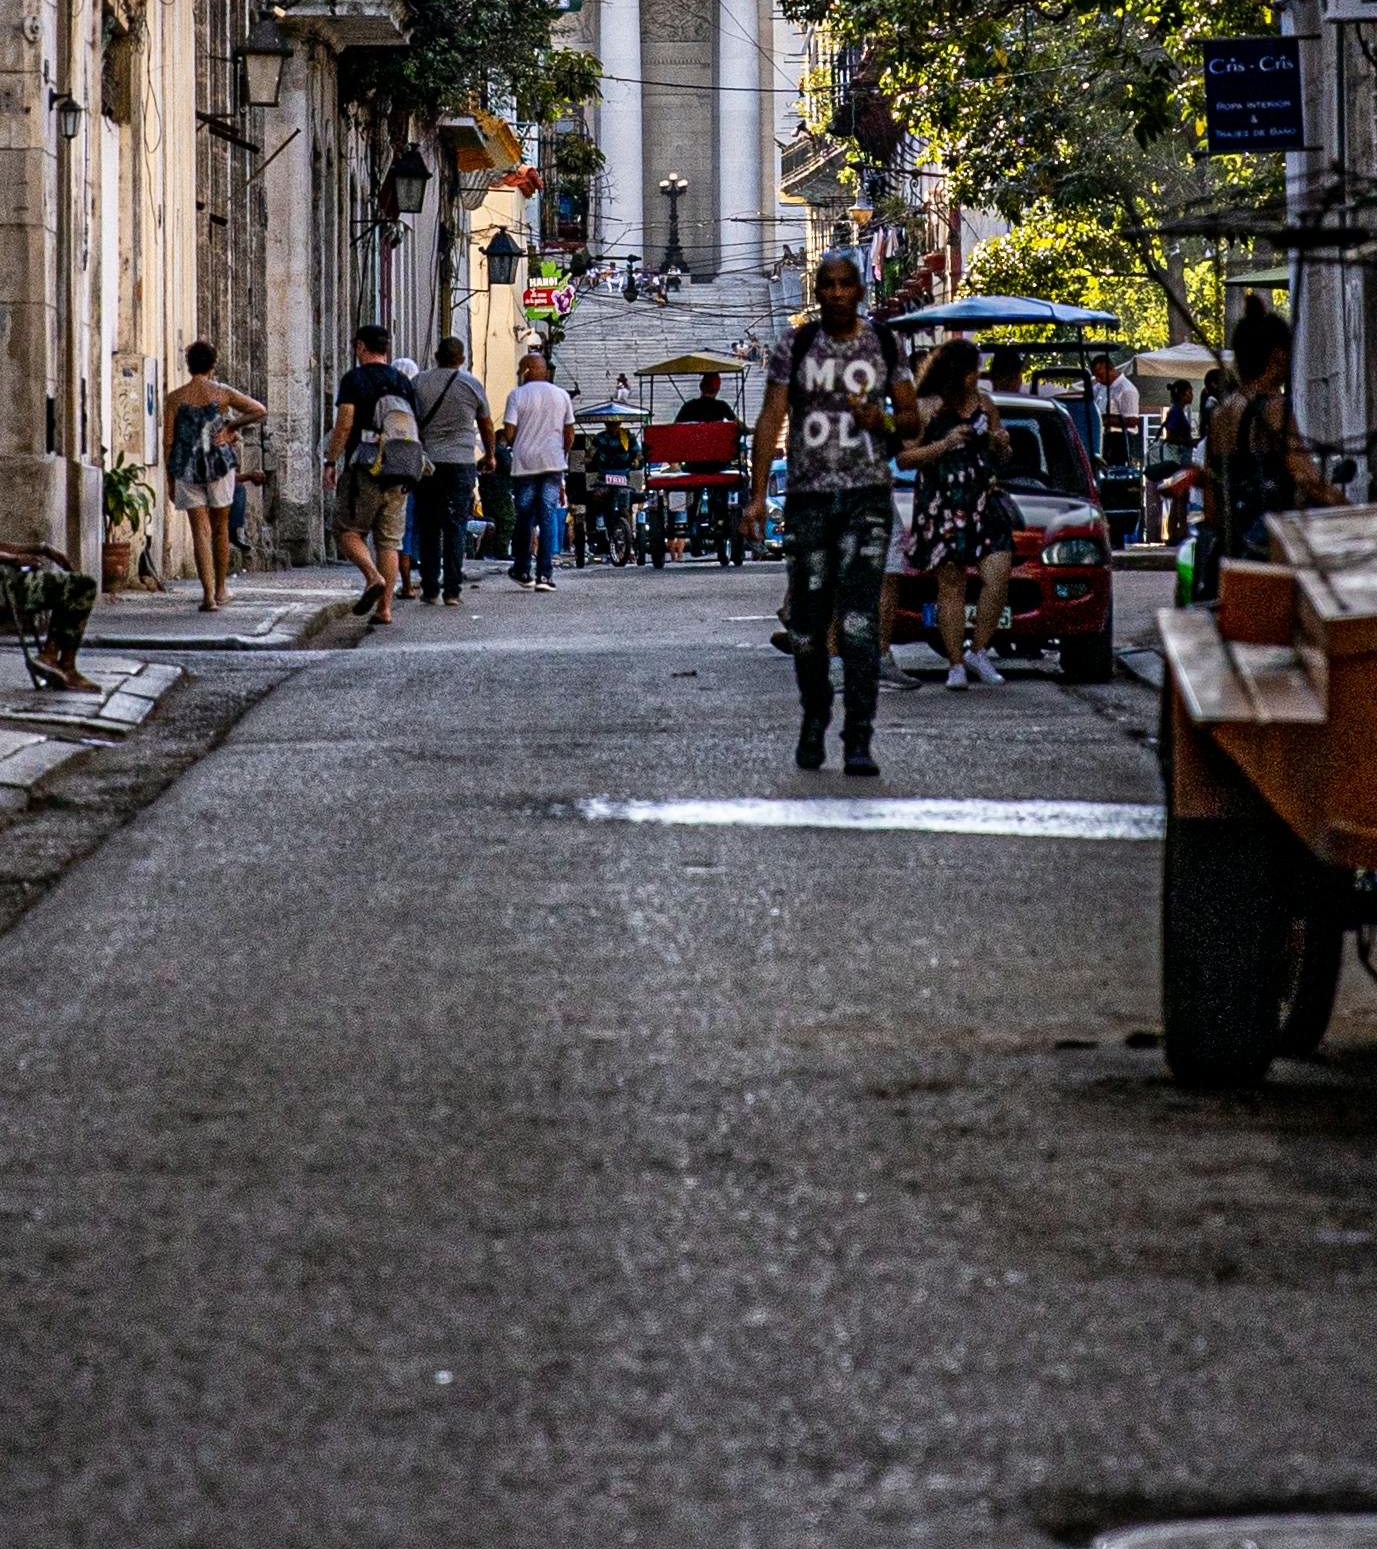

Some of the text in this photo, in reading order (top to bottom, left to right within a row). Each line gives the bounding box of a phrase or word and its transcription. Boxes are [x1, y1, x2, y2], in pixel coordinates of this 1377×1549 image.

[1208, 57, 1246, 75] Cris
[1259, 54, 1294, 72] Cris
[529, 277, 558, 287] HANOI
[805, 357, 877, 394] MO
